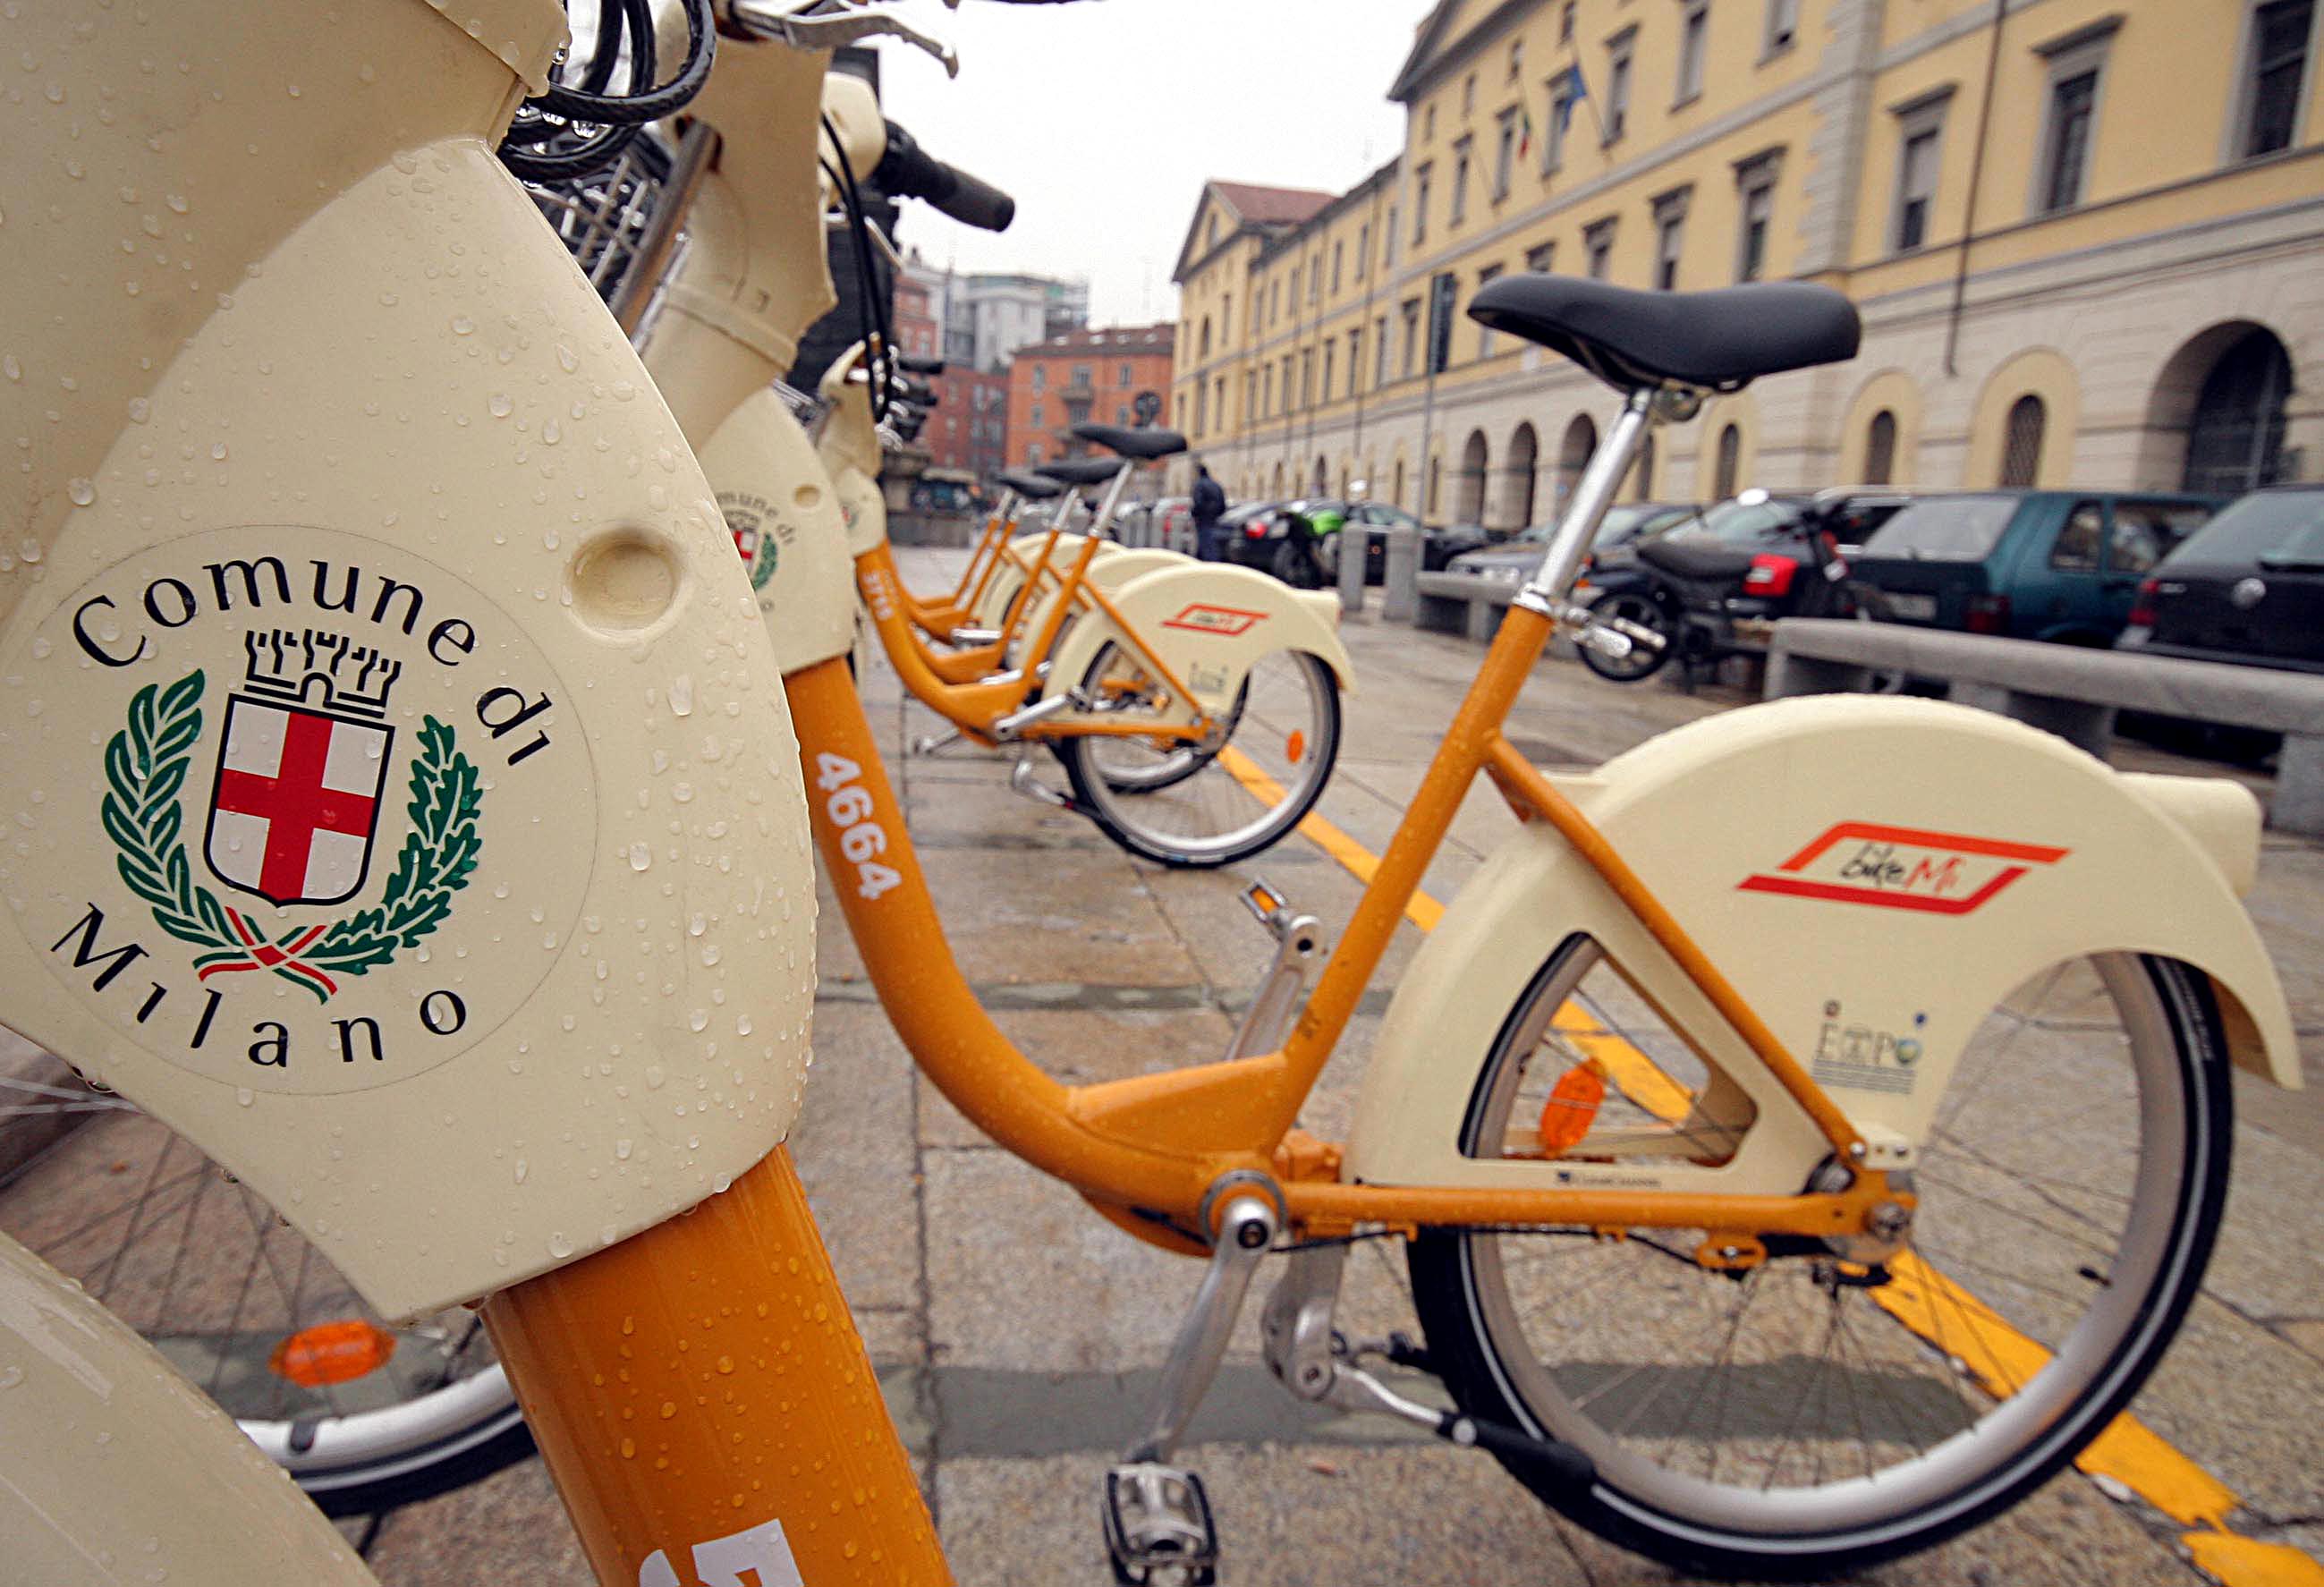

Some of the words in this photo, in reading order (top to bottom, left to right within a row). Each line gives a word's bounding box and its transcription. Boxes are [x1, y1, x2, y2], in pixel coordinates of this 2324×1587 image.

[72, 556, 476, 667] Comune
[476, 686, 553, 767] di
[816, 752, 902, 900] 4664
[51, 902, 467, 1068] Milano
